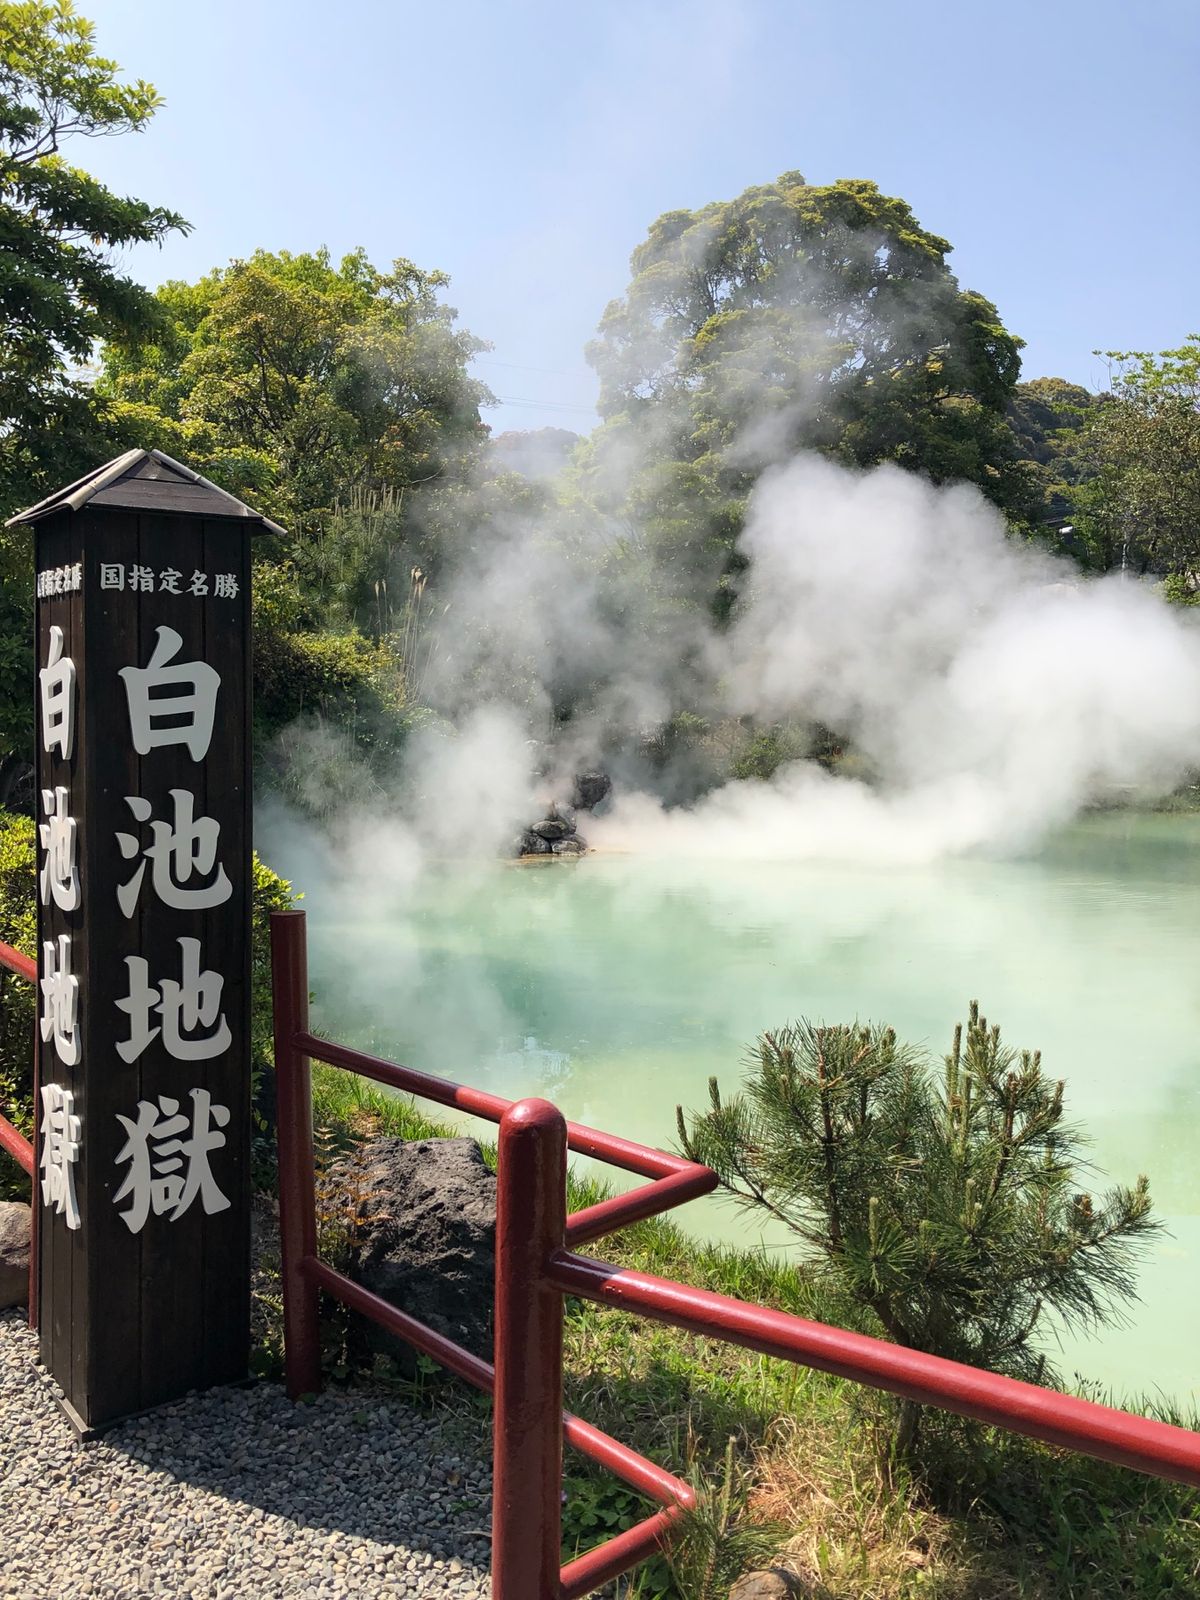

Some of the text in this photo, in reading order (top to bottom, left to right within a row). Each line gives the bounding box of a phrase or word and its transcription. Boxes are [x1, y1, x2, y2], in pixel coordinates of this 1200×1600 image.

[100, 563, 240, 599] 国指定名勝
[39, 625, 81, 1231] 白池地獄
[113, 625, 233, 1234] 白池地獄
